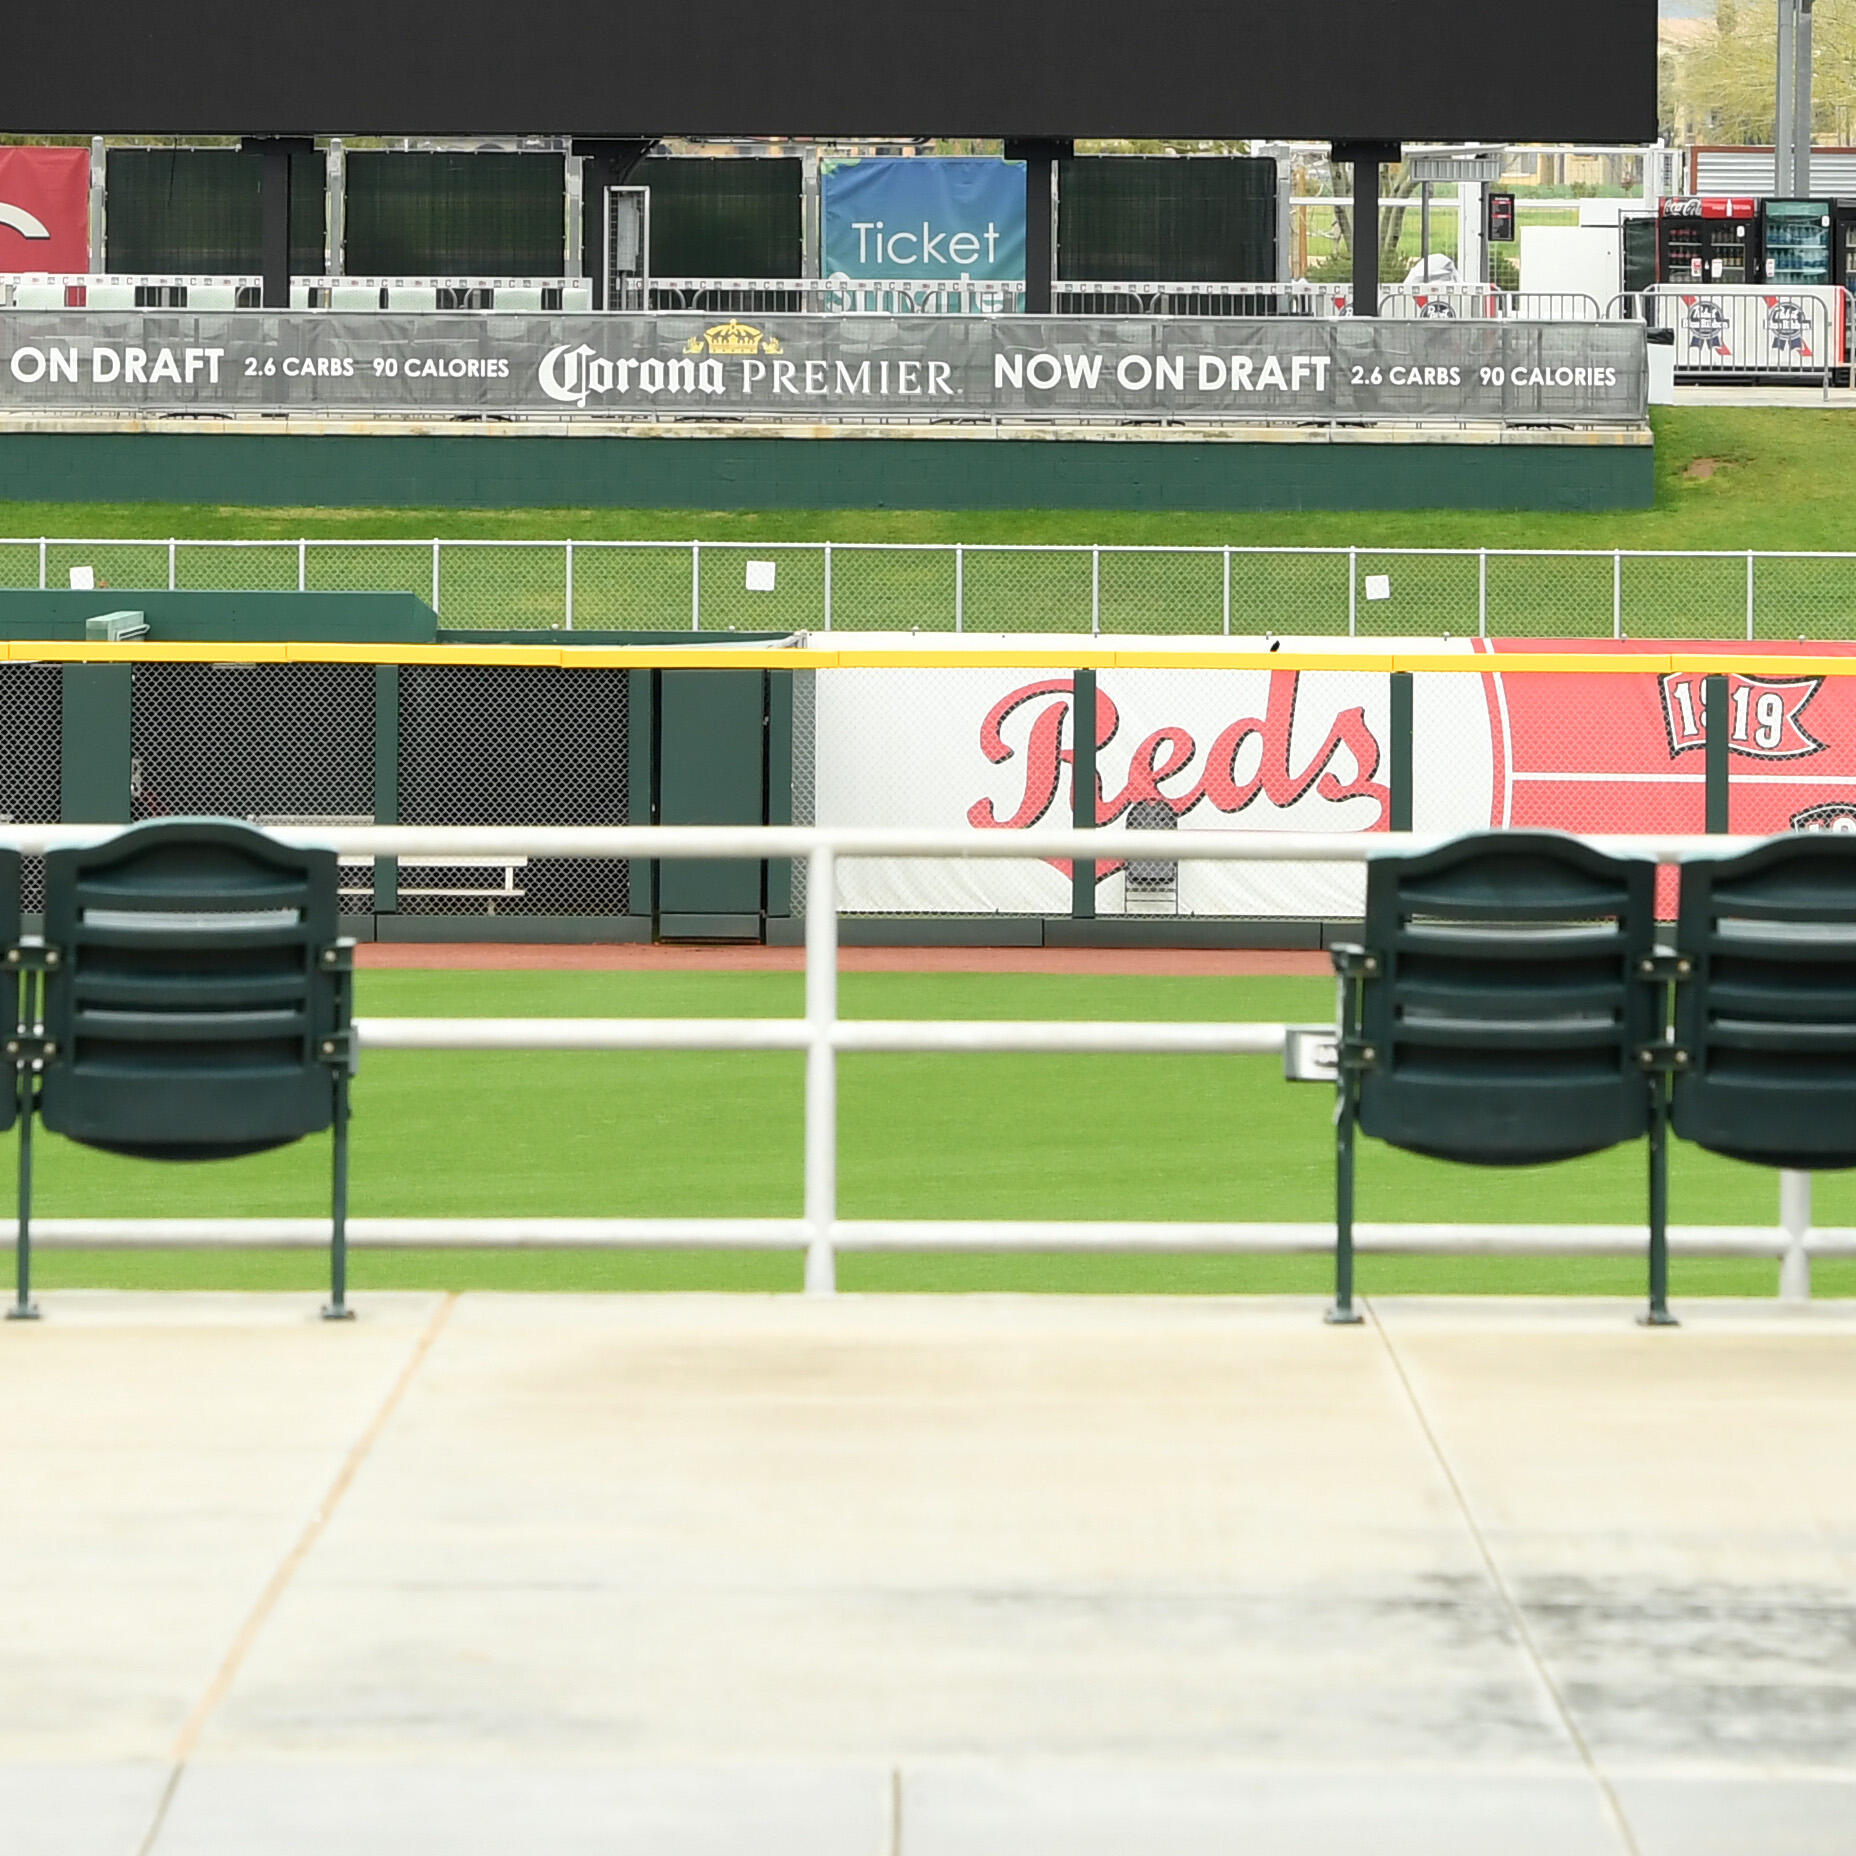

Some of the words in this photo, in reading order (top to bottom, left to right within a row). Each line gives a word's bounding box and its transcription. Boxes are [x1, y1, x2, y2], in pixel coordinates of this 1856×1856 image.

[851, 221, 1000, 265] Ticket
[10, 347, 79, 383] ON
[92, 347, 225, 384] DRAFT
[244, 357, 276, 377] 2.6
[282, 357, 354, 377] CARBS
[373, 357, 399, 378] 90
[404, 357, 510, 379] CALORIES
[538, 344, 726, 407] Corona
[742, 359, 959, 395] PREMIER
[993, 354, 1102, 390] NOW
[1117, 355, 1186, 391] ON
[1199, 356, 1331, 392] DRAFT
[1350, 365, 1383, 386] 2.6
[1388, 365, 1461, 387] CARBS
[1480, 366, 1506, 387] 90
[1510, 366, 1617, 387] CALORIES
[967, 670, 1390, 834] Reds
